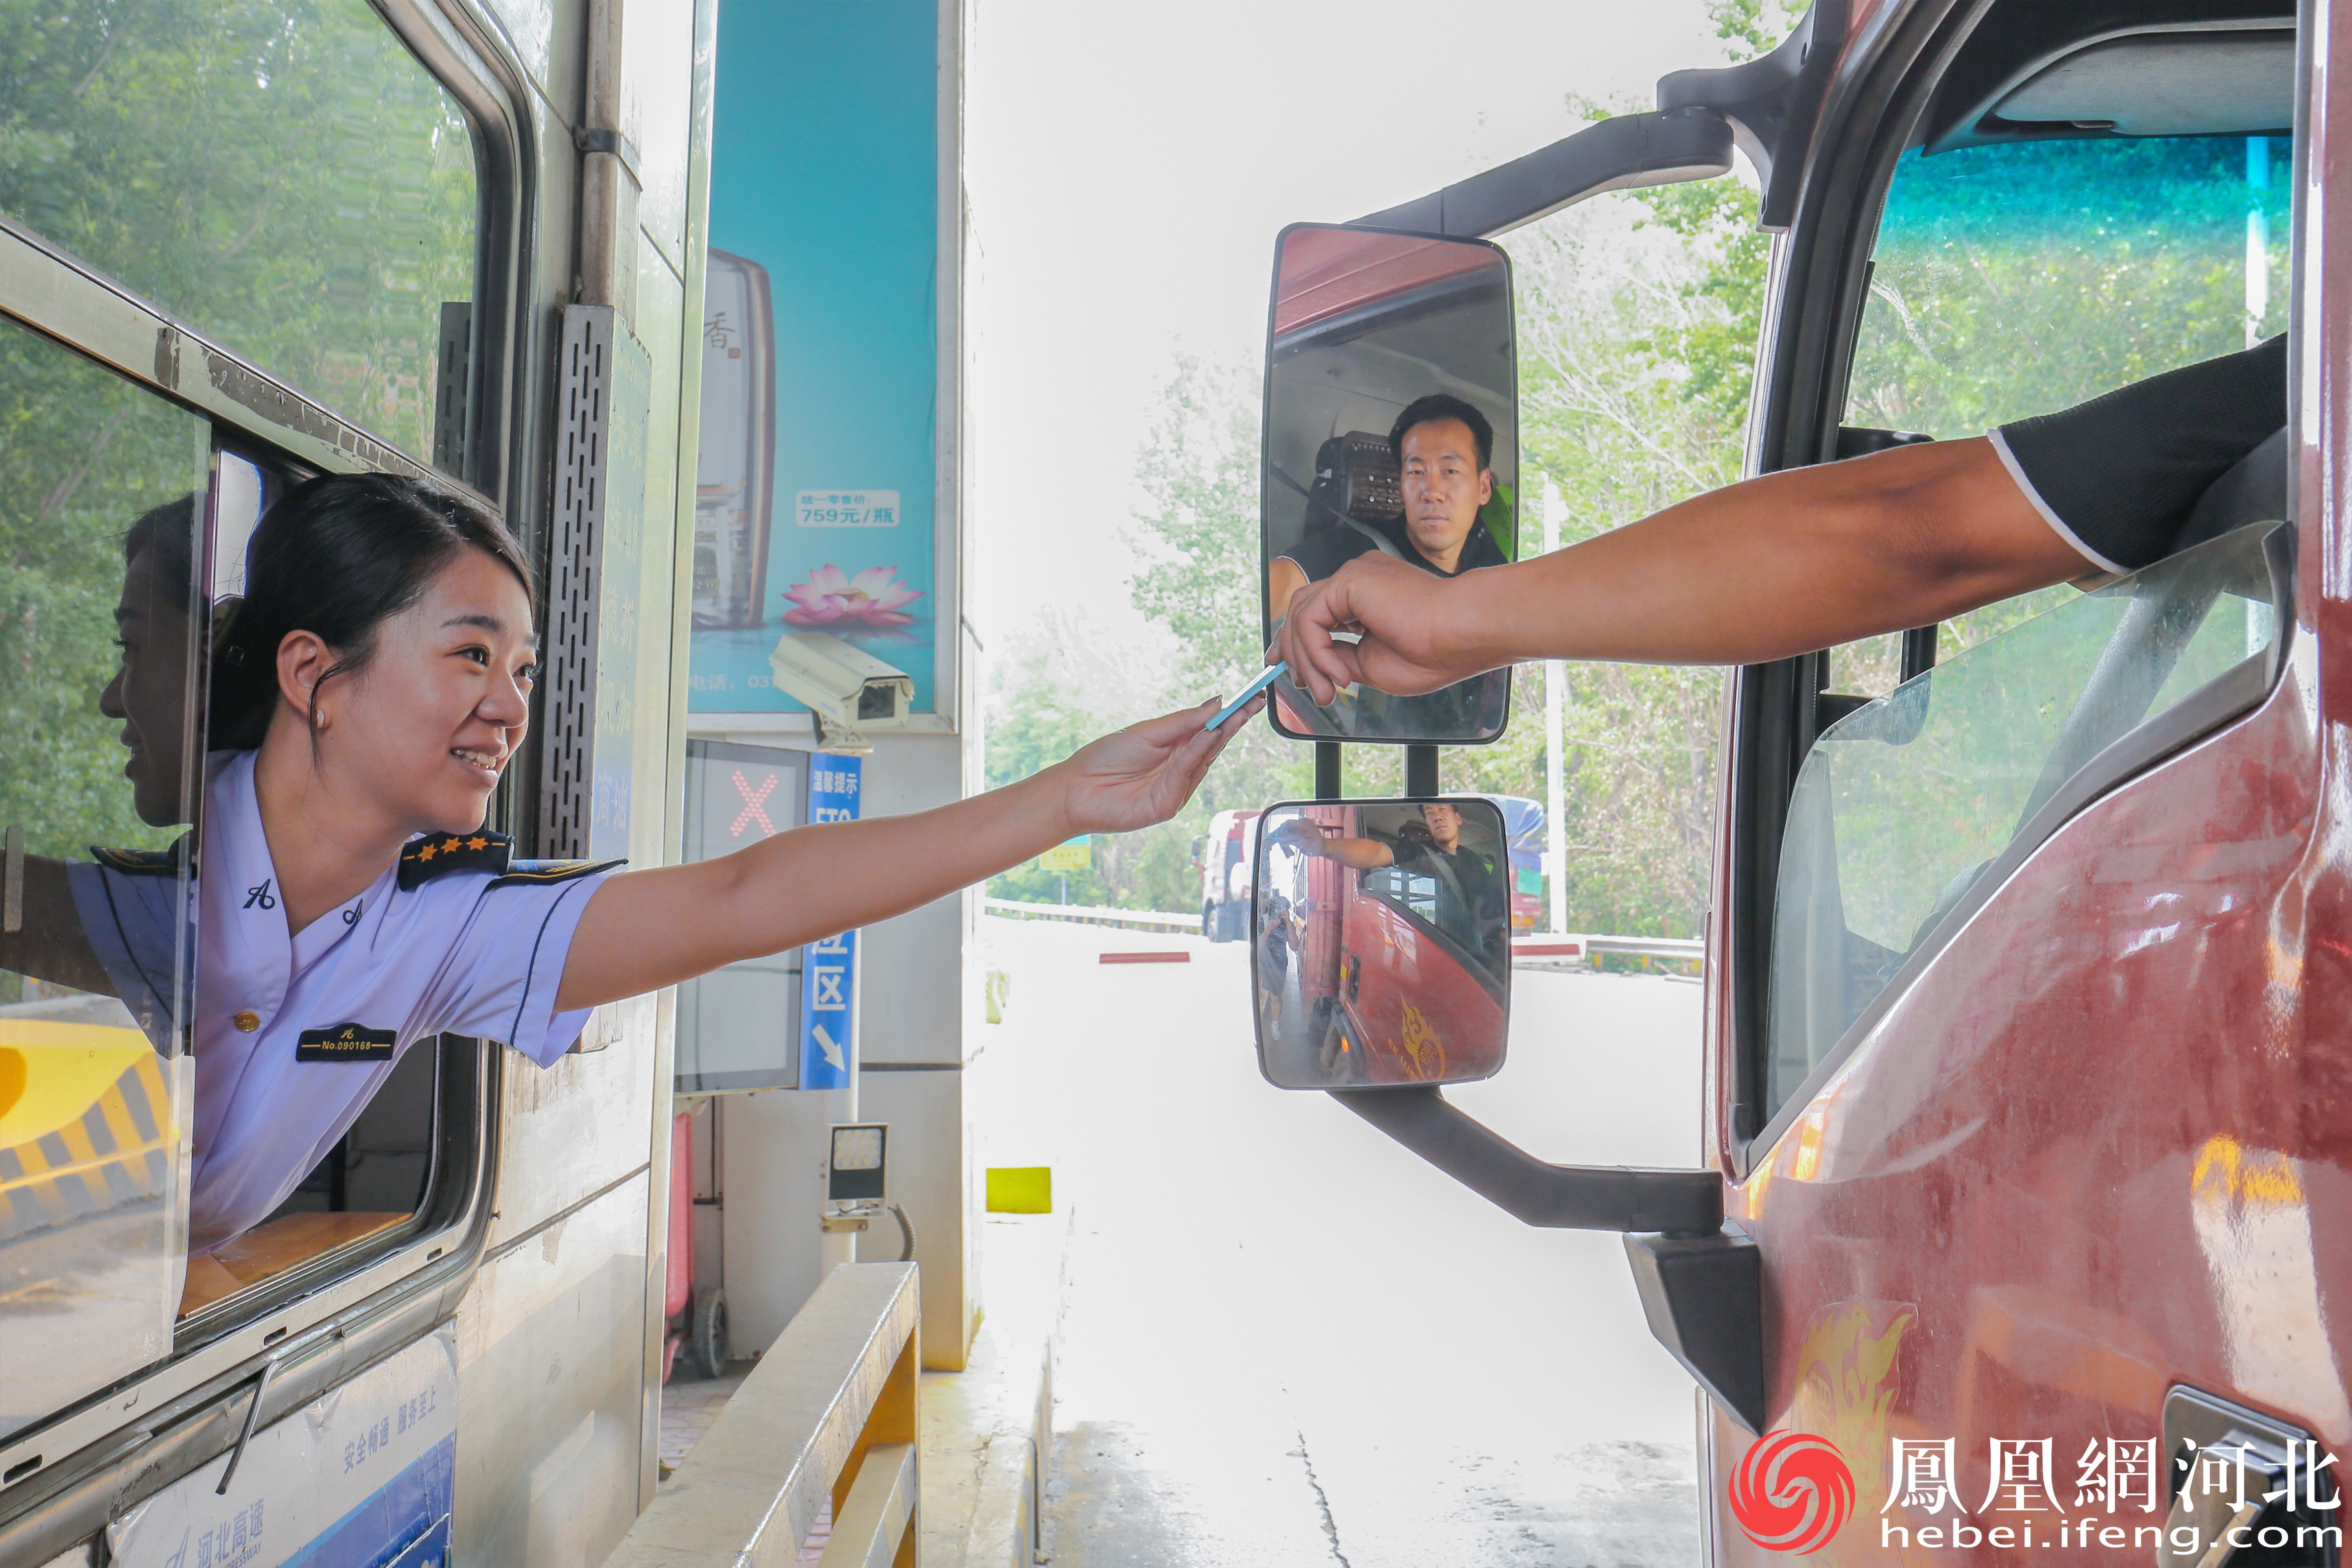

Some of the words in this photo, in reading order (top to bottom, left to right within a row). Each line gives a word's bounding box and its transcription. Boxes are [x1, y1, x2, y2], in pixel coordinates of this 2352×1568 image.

[704, 312, 736, 349] 香
[801, 508, 895, 523] 759元/瓶
[813, 770, 858, 795] 温馨提示
[322, 1041, 371, 1050] No.090168
[344, 1414, 390, 1475] 安全畅通
[397, 1384, 436, 1436] 服务至上
[198, 1498, 265, 1568] 河北高速
